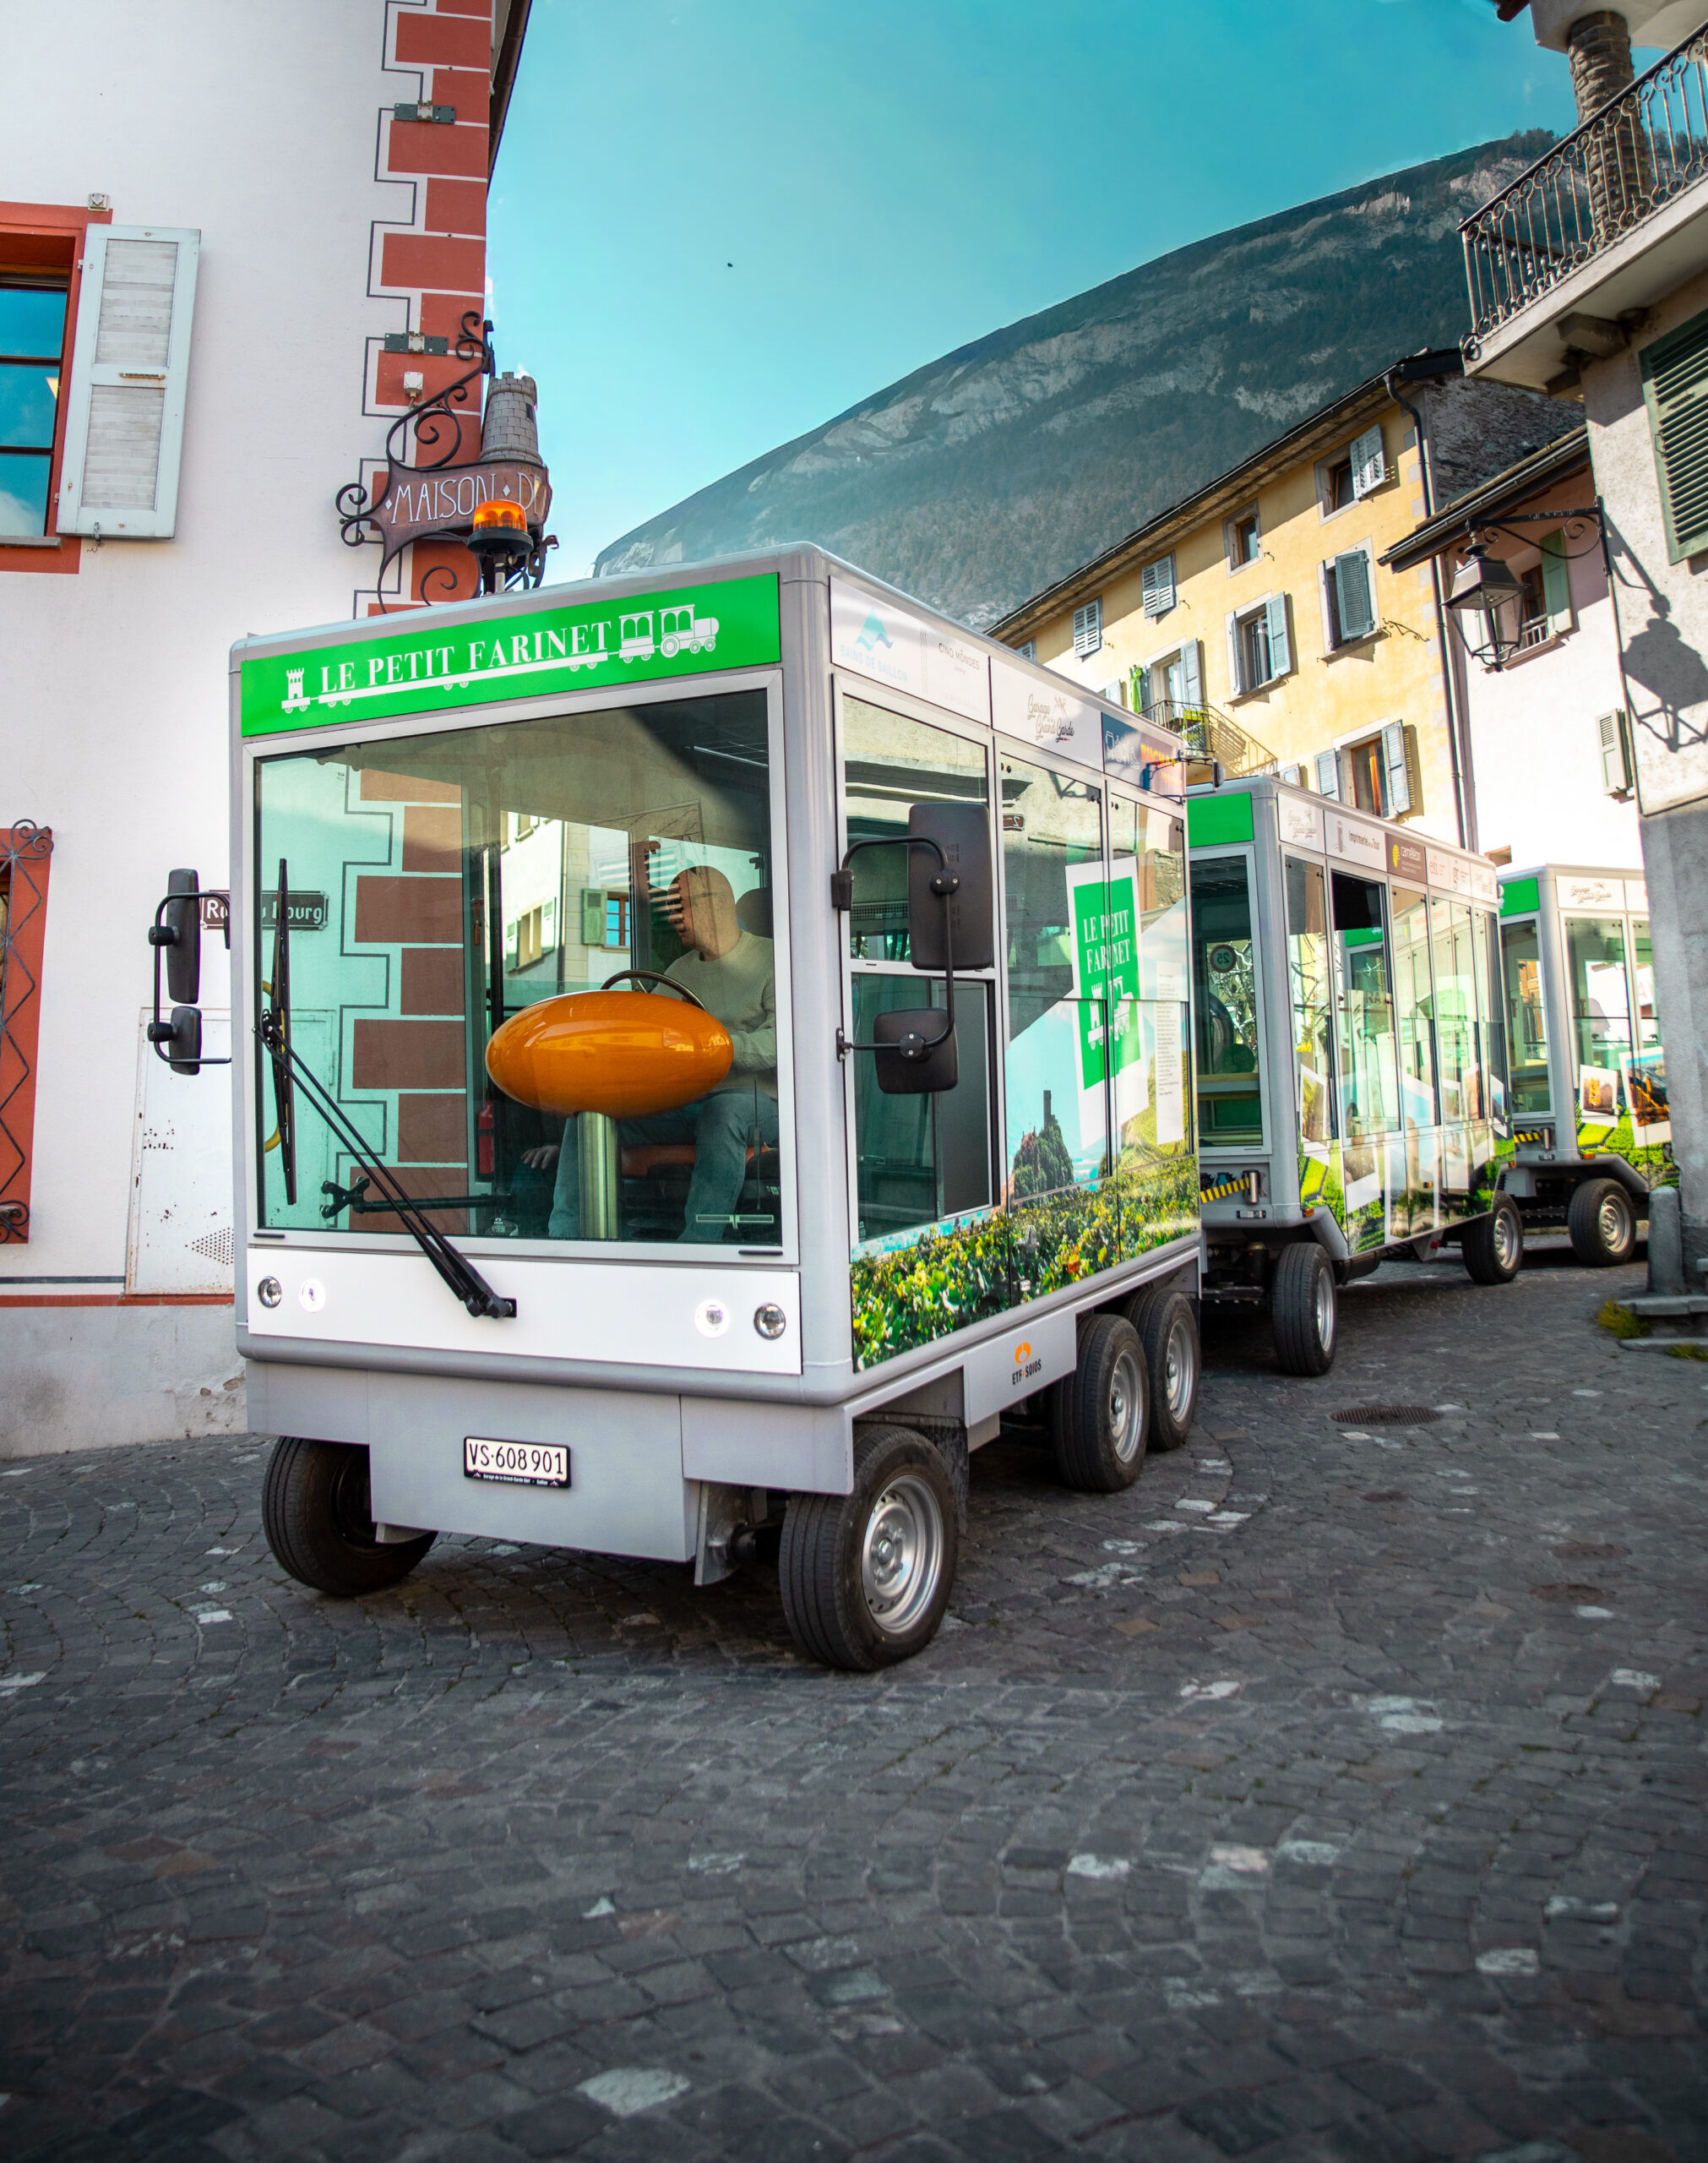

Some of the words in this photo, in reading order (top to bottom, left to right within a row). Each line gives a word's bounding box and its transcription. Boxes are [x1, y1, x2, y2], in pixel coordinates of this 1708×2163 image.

[391, 473, 496, 524] MAISON
[321, 662, 356, 693] LE
[367, 646, 454, 685] PETIT
[468, 621, 612, 670] FARINET
[1083, 917, 1097, 943] LE
[1100, 909, 1129, 939] PETIT
[1086, 939, 1130, 973] FARINET
[1012, 1369, 1022, 1386] ETF
